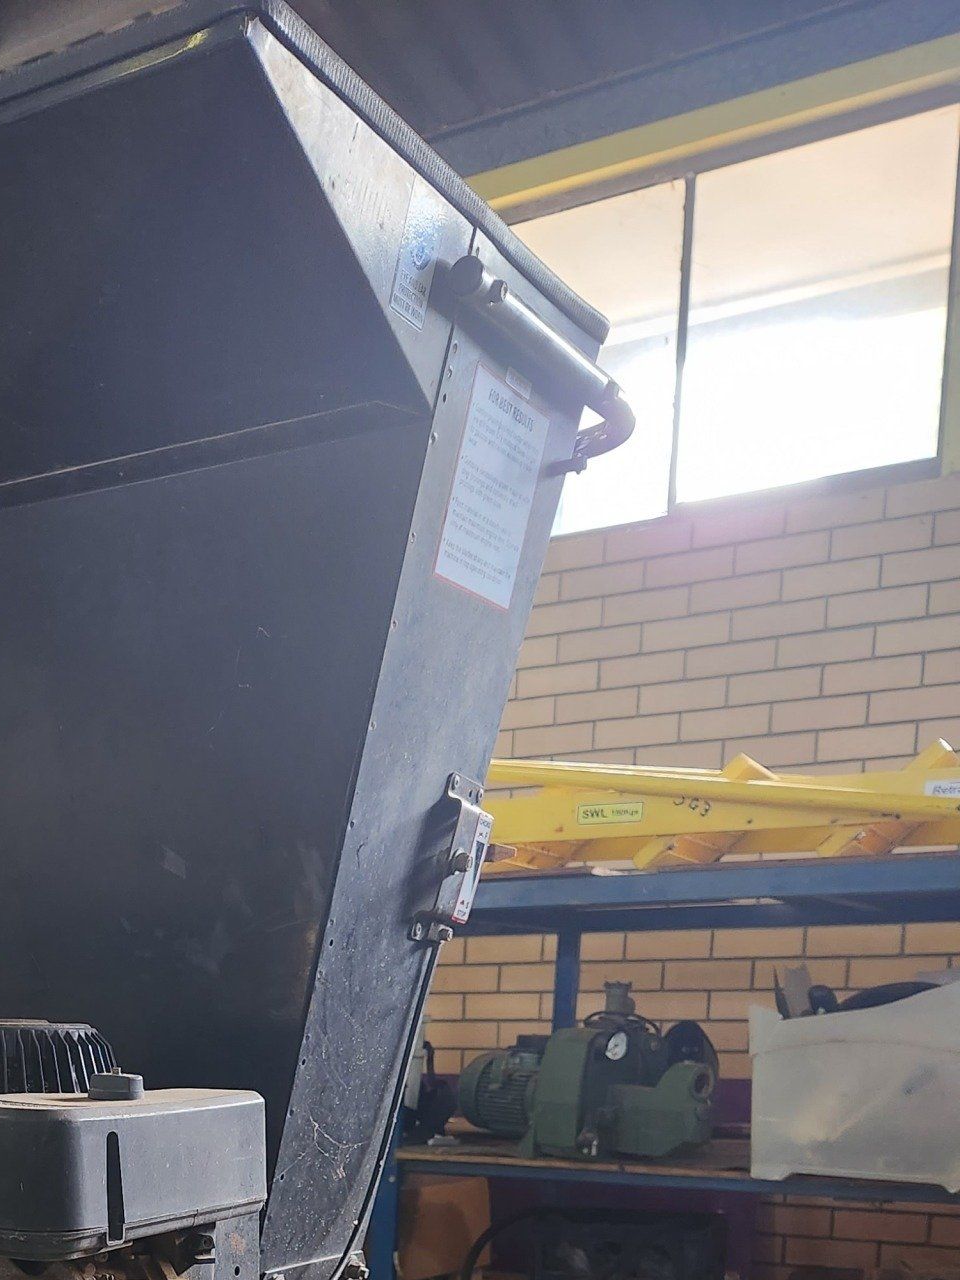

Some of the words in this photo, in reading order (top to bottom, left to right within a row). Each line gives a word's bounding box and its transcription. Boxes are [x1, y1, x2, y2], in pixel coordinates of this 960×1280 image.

[488, 388, 500, 406] FOR
[499, 396, 514, 415] BEST
[513, 406, 534, 432] RESULTS
[582, 808, 608, 819] SWL
